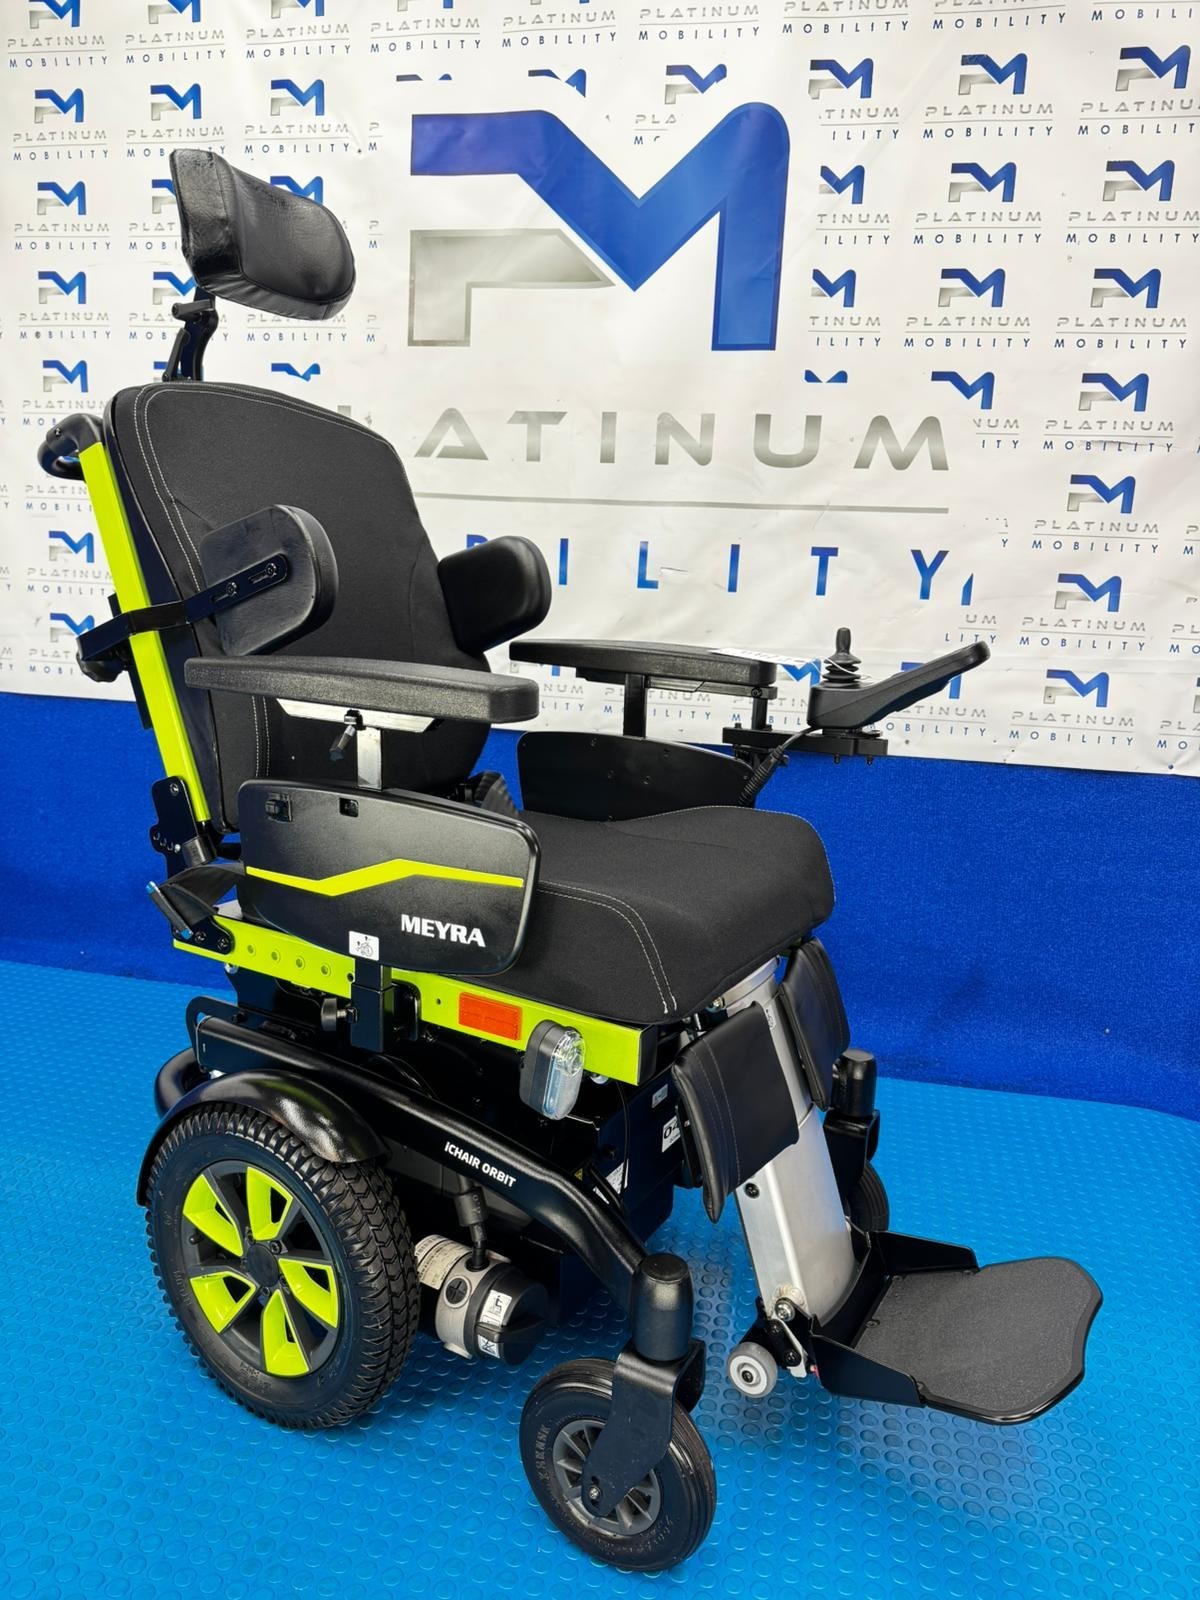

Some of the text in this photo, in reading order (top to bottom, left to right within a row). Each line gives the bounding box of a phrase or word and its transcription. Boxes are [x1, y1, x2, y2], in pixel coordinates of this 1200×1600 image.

[502, 10, 616, 27] PLATINUM
[639, 5, 759, 19] PLATINUM
[1091, 8, 1192, 22] MOBILI
[370, 18, 480, 33] PLATINUM
[782, 21, 908, 34] MOBILITY
[933, 13, 1065, 30] MOBILITY
[125, 29, 224, 44] PLATINUM
[246, 24, 349, 39] PLATINUM
[639, 28, 759, 41] MOBILITY
[7, 35, 105, 48] PLATINUM
[370, 40, 481, 53] MOBILITY
[502, 32, 616, 48] MOBILITY
[126, 50, 226, 64] MOBILITY
[246, 45, 351, 60] MOBILITY
[9, 56, 107, 69] MOBILITY
[925, 103, 1053, 117] PLATINUM
[1080, 98, 1200, 113] PLATINU
[818, 107, 899, 120] TINUM
[126, 126, 224, 139] PLATINUM
[245, 123, 348, 136] PLATINUM
[923, 126, 1052, 139] MOBILITY
[1078, 123, 1195, 136] MOBILIT
[12, 132, 107, 143] PLATINUM
[13, 149, 108, 161] MOBILITY
[245, 144, 349, 155] MOBILITY
[915, 211, 1042, 223] PLATINUM
[1068, 210, 1200, 222] PLATINUM
[14, 223, 109, 233] PLATINUM
[129, 222, 175, 232] PLAT
[913, 234, 1041, 245] MOBILITY
[1066, 233, 1200, 244] MOBILITY
[14, 242, 110, 251] MOBILITY
[129, 242, 178, 251] MOBI
[19, 312, 109, 322] PLATINUM
[906, 316, 1030, 328] PLATINUM
[1056, 316, 1187, 329] PLATINUM
[19, 331, 110, 341] MOBILITY
[129, 331, 228, 342] MOBY
[247, 332, 347, 342] MOBILITY
[904, 338, 1030, 348] MOBILITY
[1054, 338, 1187, 350] MOBILITY
[1045, 419, 1174, 432] PLATINUM
[337, 407, 949, 471] ATINUM
[1043, 440, 1173, 453] MOBILITY
[1034, 519, 1159, 533] PLATINUM
[1031, 540, 1159, 554] MOBILITY
[466, 533, 949, 601] ILITY
[1022, 616, 1146, 631] PLATINUM
[1019, 636, 1146, 651] MOBILITY
[604, 687, 711, 702] PLTINUM
[604, 704, 711, 720] MILITY
[900, 705, 986, 718] TINUM
[1012, 710, 1134, 727] PLATINUM
[1009, 730, 1133, 747] MOBILITY
[401, 914, 486, 948] MEYRA
[444, 1141, 517, 1188] ICHAIR ORBIT
